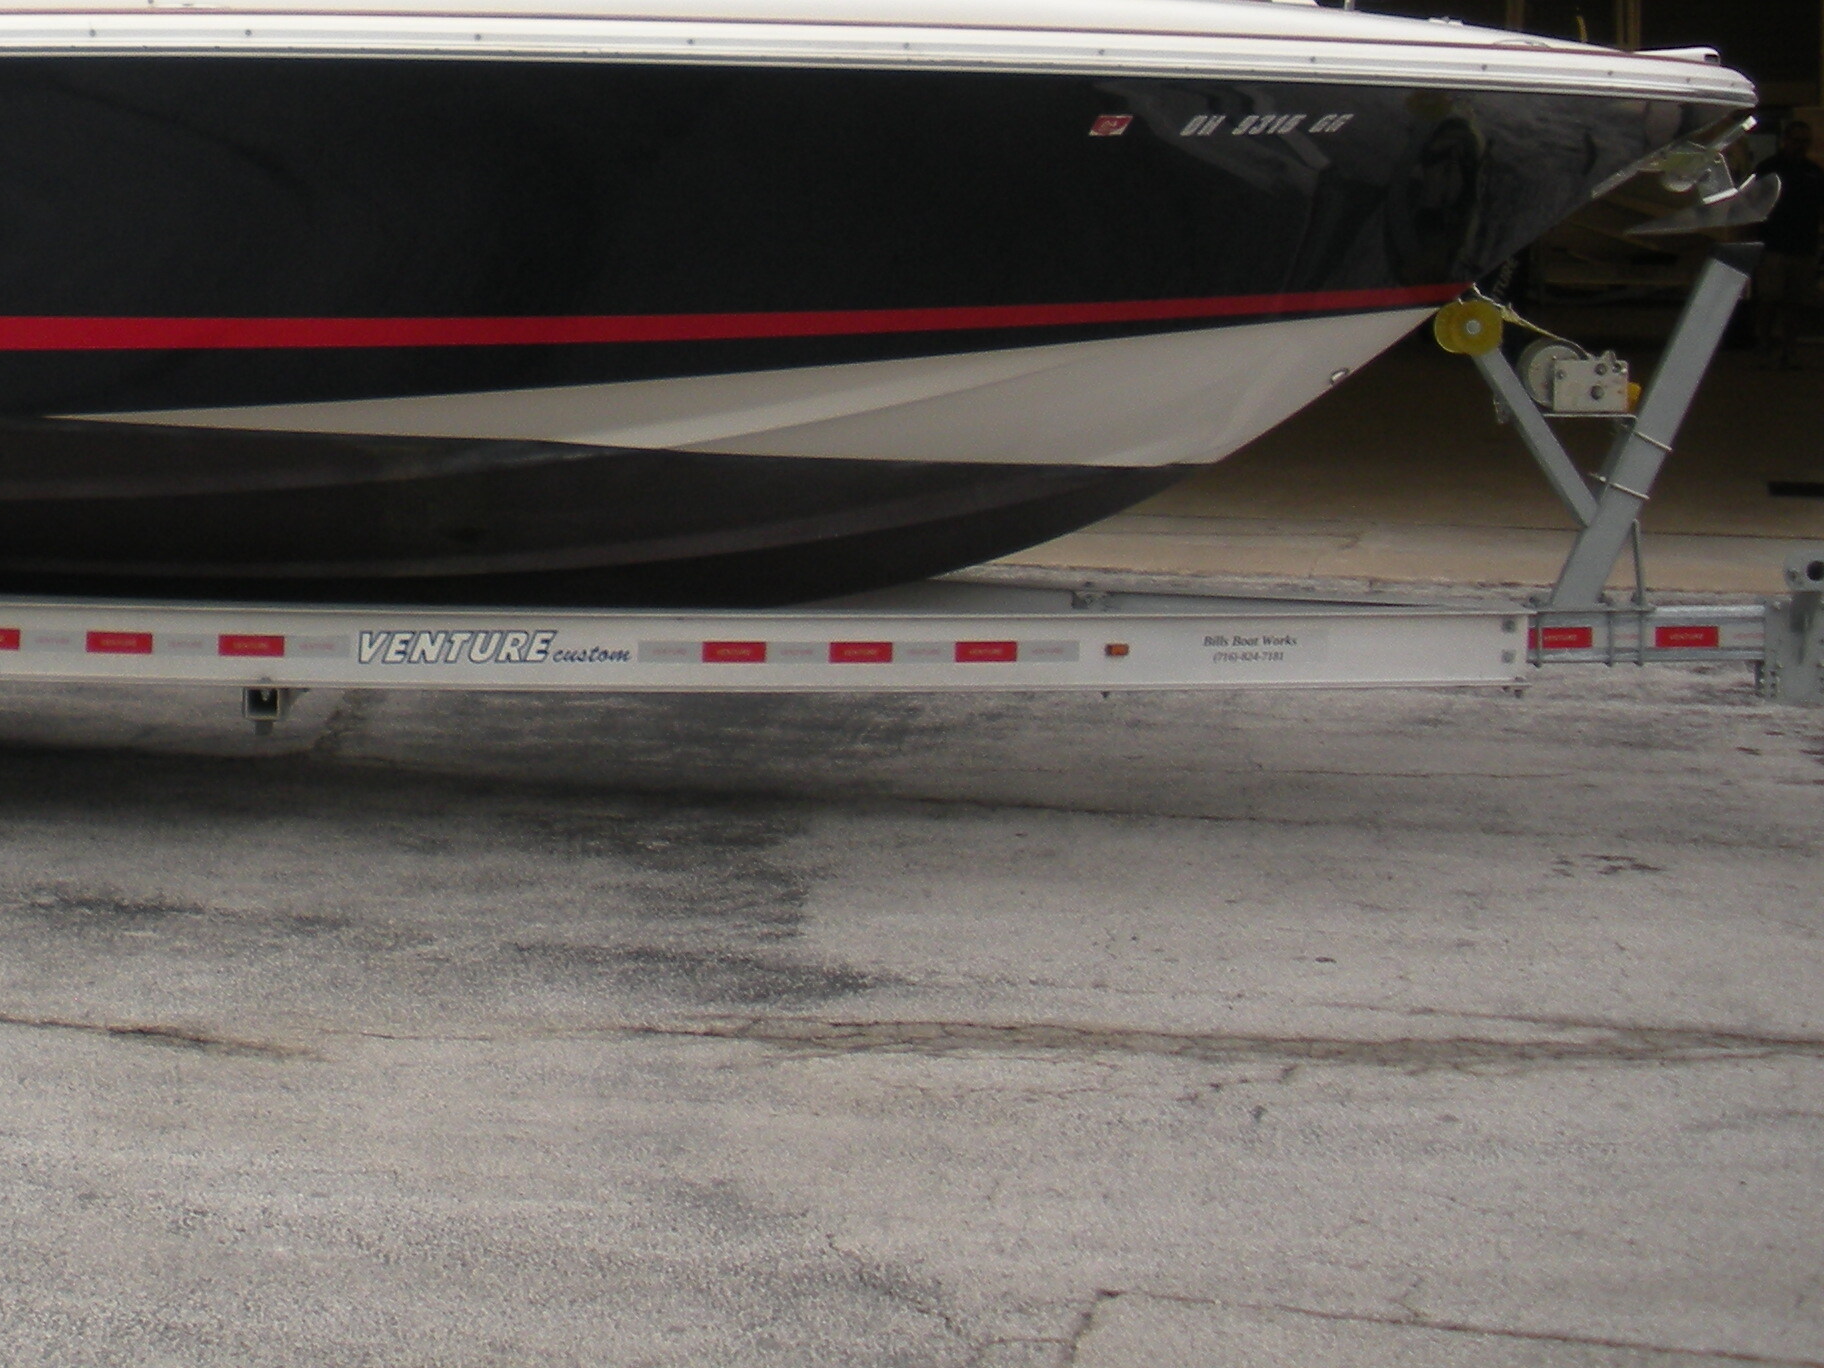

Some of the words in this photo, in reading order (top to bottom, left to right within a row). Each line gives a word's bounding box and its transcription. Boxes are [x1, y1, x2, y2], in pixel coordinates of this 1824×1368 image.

[358, 630, 558, 664] VENTURE
[552, 646, 631, 662] custom
[1262, 635, 1298, 647] Works
